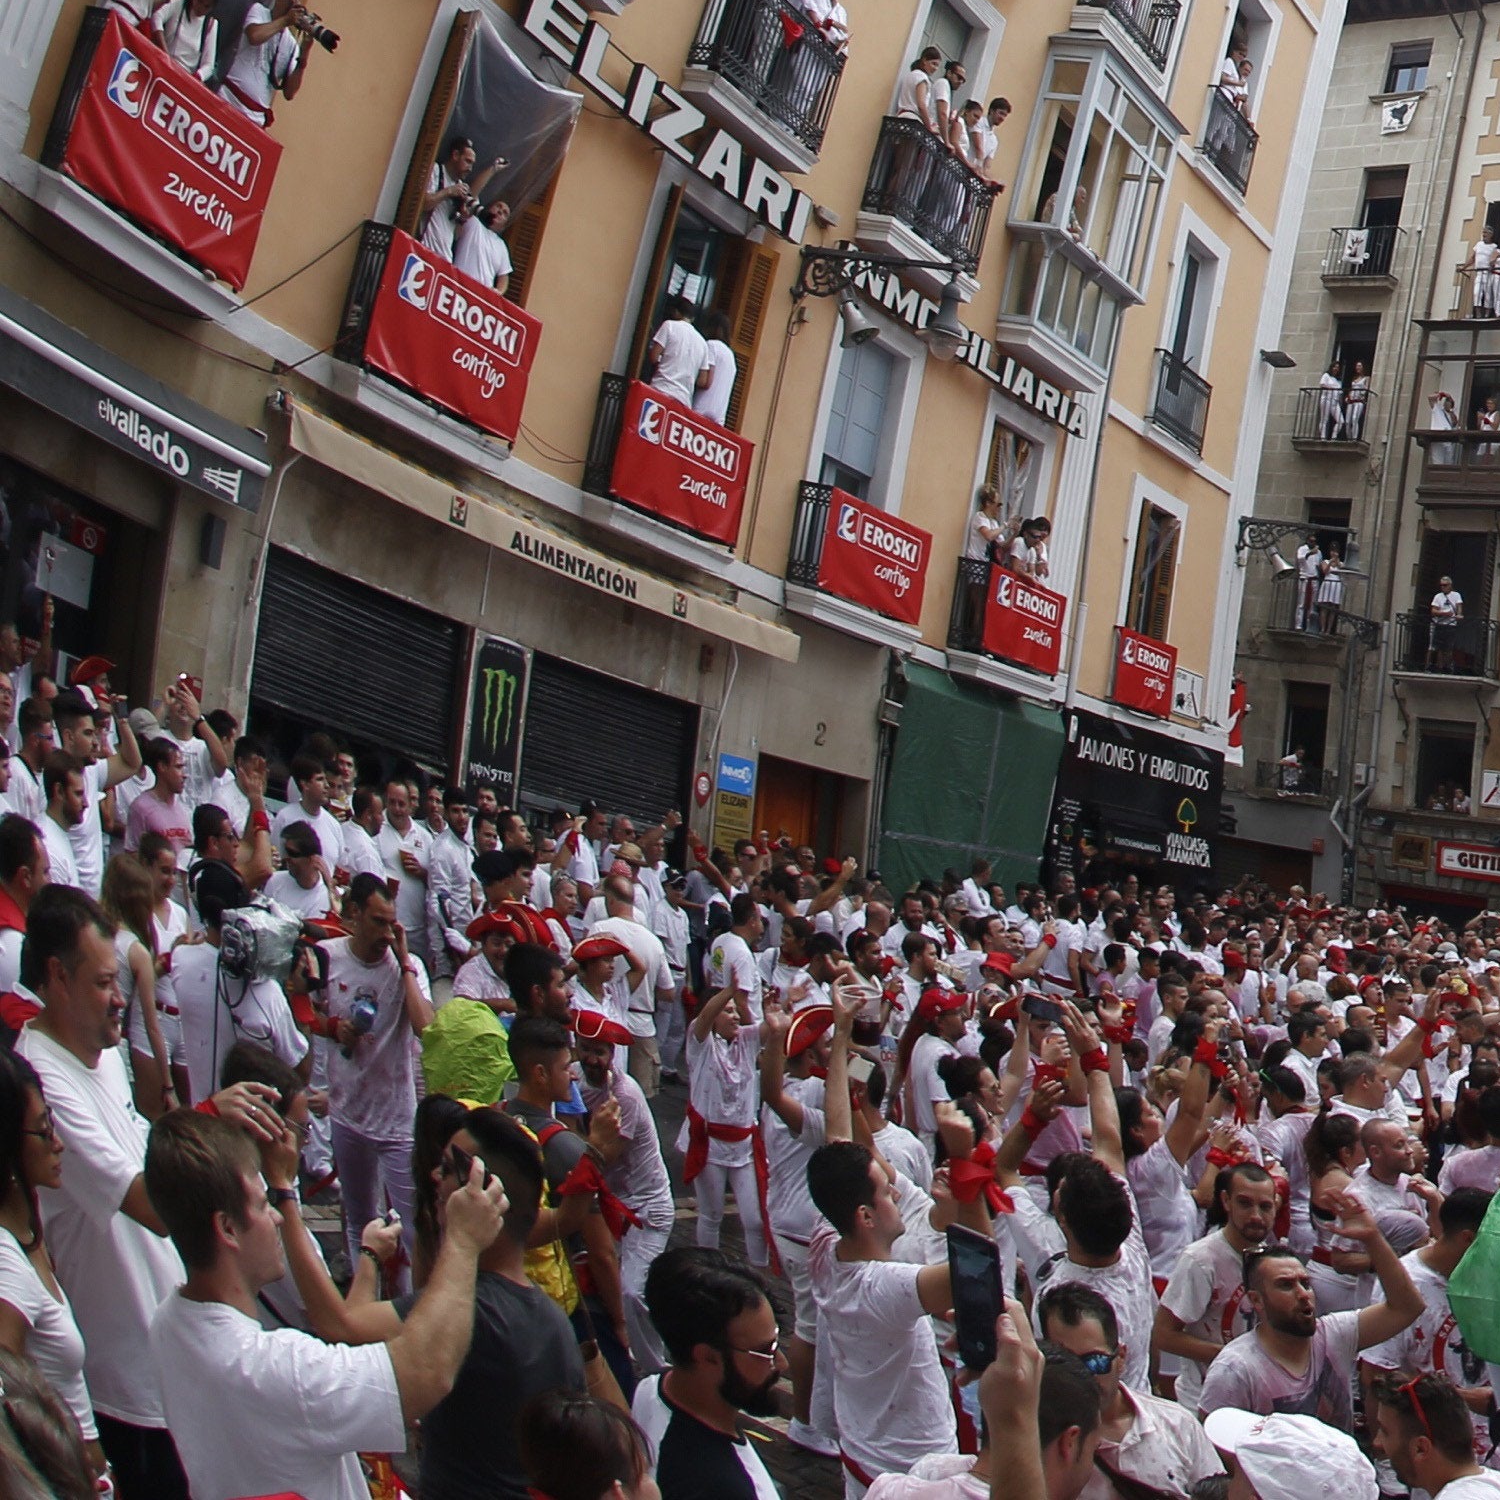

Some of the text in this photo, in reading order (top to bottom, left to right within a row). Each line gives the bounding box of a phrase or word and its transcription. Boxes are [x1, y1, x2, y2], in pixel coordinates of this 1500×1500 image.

[152, 92, 250, 186] EROSKI
[436, 285, 518, 355] EROSKI
[452, 348, 505, 399] contigo
[669, 420, 735, 472] EROSKI
[511, 530, 637, 599] ALIMENTACIÓN
[863, 522, 918, 563] EROSKI
[874, 564, 910, 597] contigo
[1016, 589, 1057, 621] EROSKI
[1137, 647, 1169, 673] EROSKI
[814, 722, 827, 746] 2
[1077, 736, 1210, 791] JAMONES Y EMBUTIDOS
